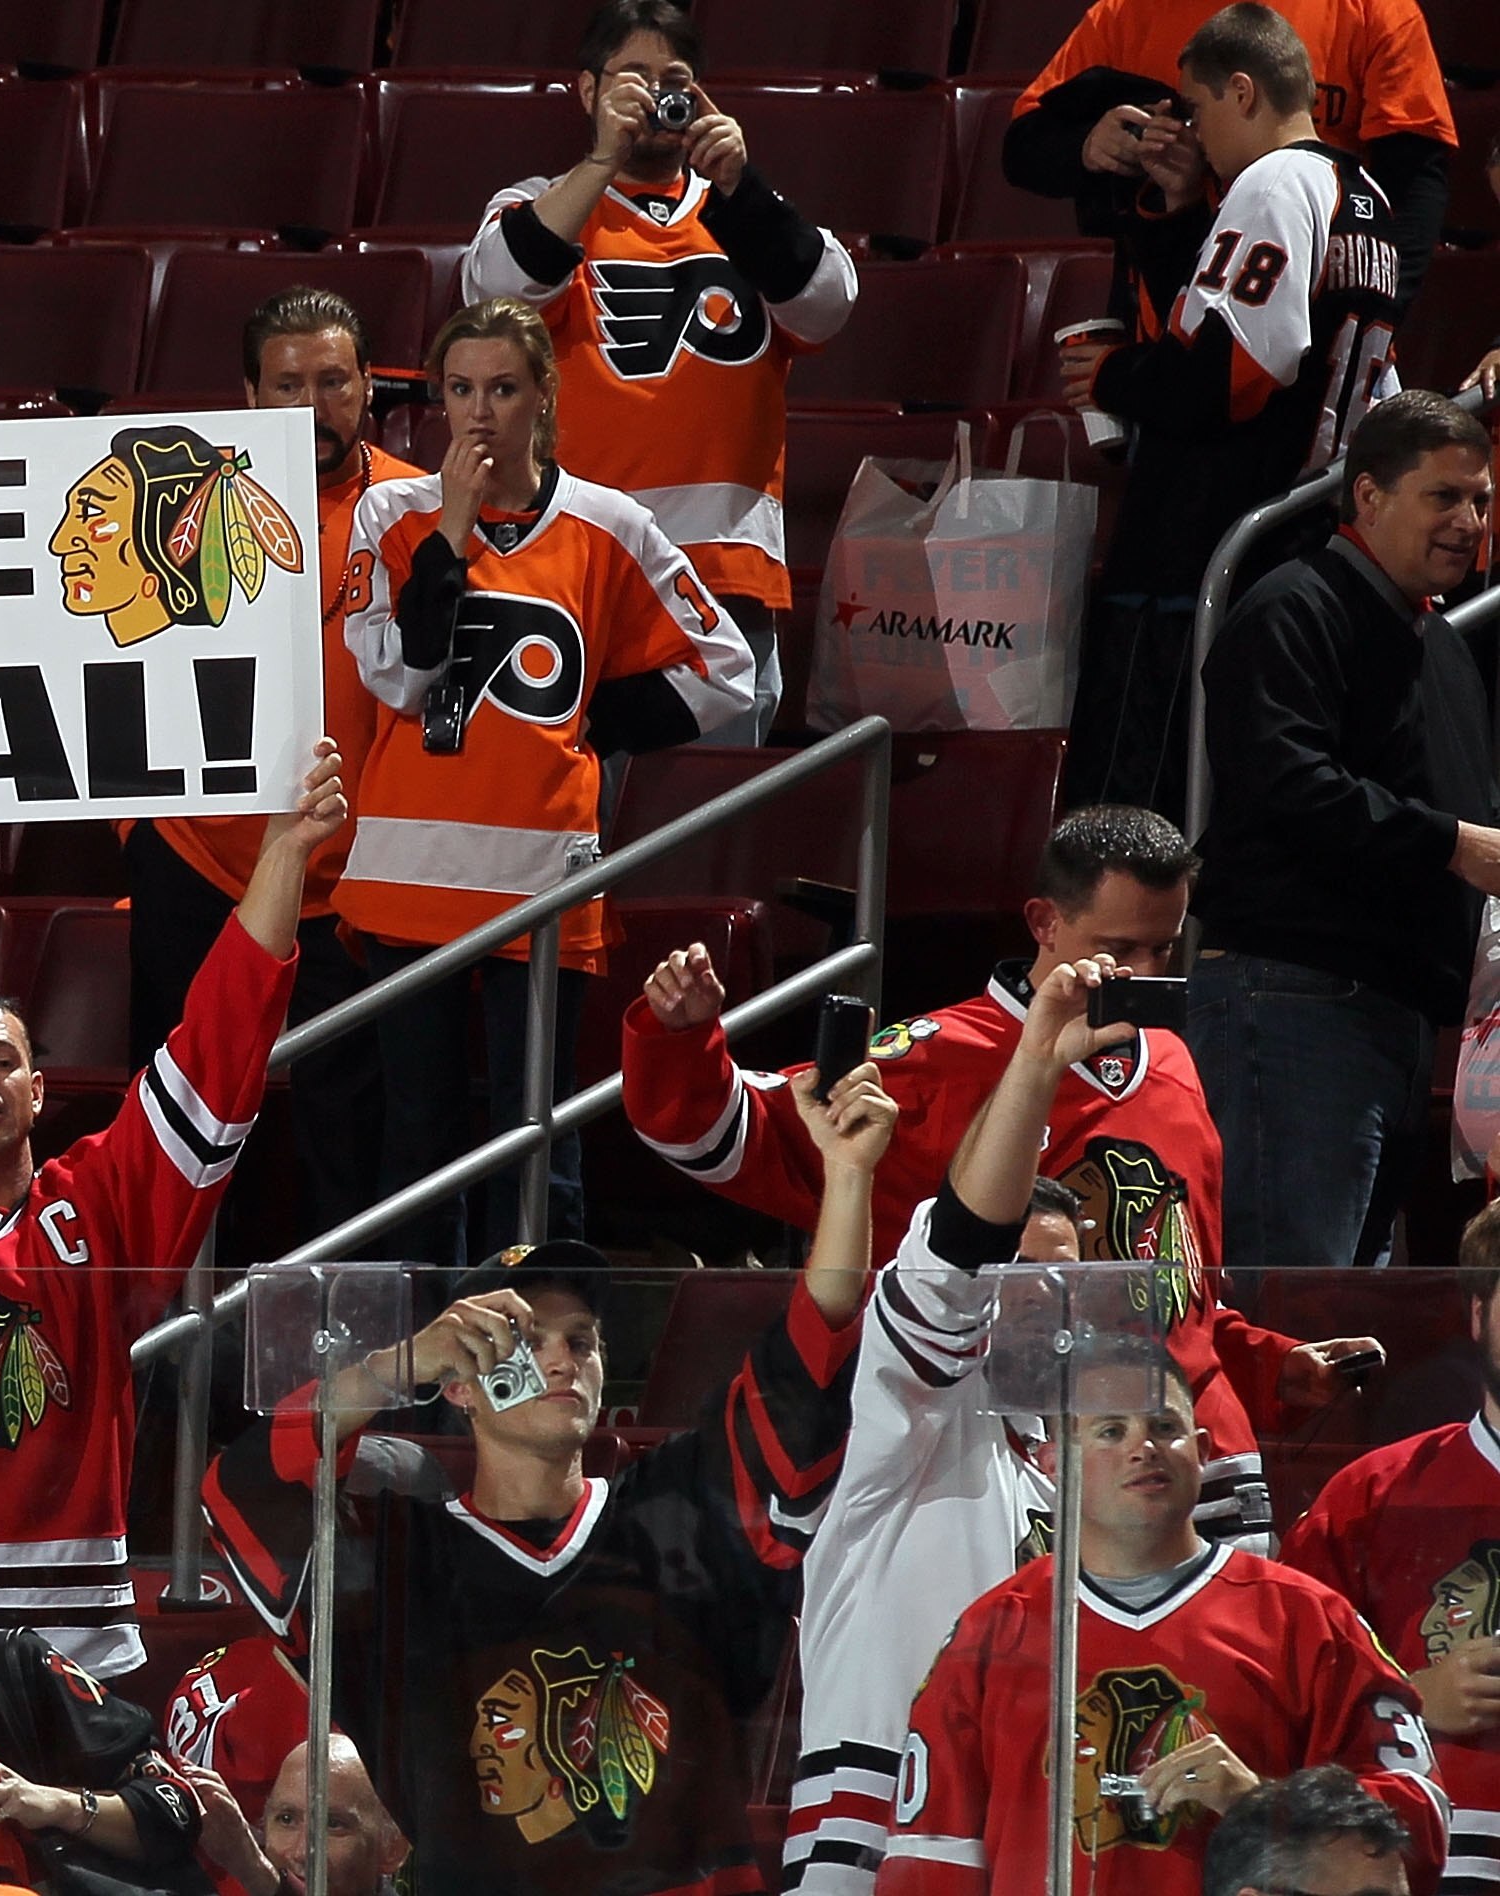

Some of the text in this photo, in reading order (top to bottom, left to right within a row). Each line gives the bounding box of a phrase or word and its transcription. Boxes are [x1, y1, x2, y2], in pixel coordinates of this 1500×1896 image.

[1195, 228, 1289, 307] 18
[868, 609, 1018, 651] ARAMARK
[39, 1199, 89, 1265] C
[1374, 1696, 1435, 1778] 3
